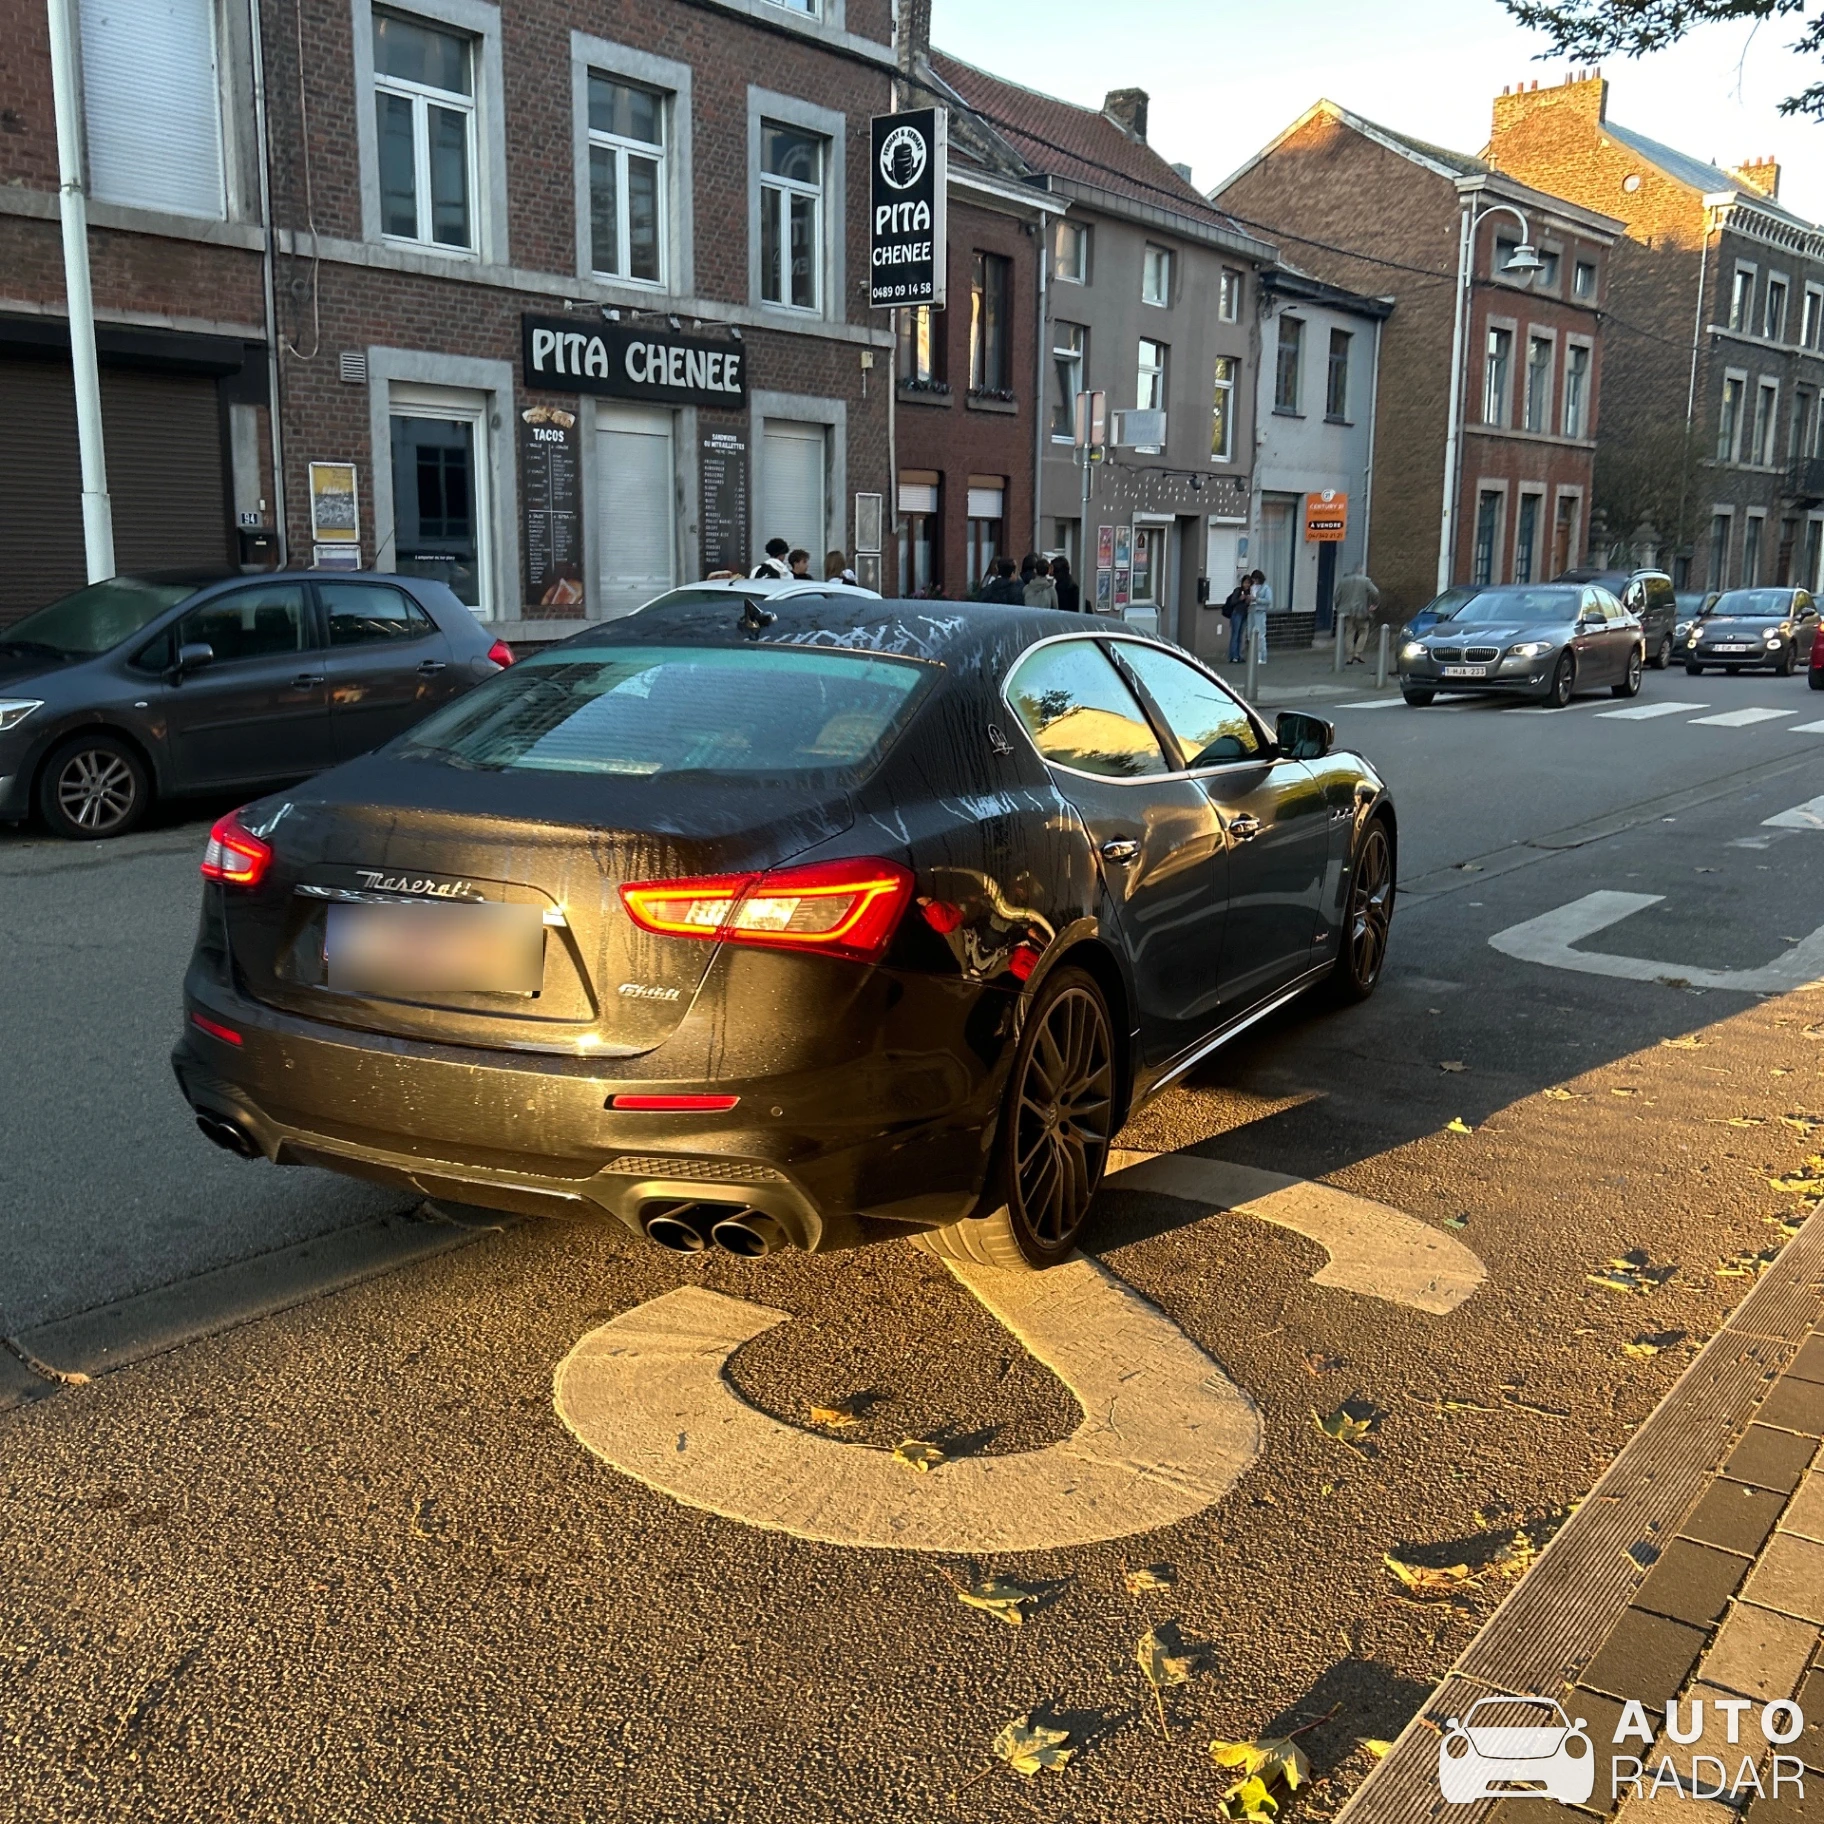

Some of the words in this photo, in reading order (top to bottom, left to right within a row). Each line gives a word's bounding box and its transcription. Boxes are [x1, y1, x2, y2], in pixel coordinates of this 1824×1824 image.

[876, 200, 930, 235] PITA
[873, 242, 931, 266] CHENEE
[872, 286, 893, 299] 0489
[894, 284, 906, 297] 09
[908, 283, 919, 296] 14
[920, 281, 932, 294] 58
[532, 328, 609, 379] PITA
[625, 341, 742, 393] CHENEE
[533, 428, 565, 442] TACOS
[244, 513, 256, 524] 94
[356, 870, 472, 898] Maserati
[618, 983, 681, 1001] Ghibli
